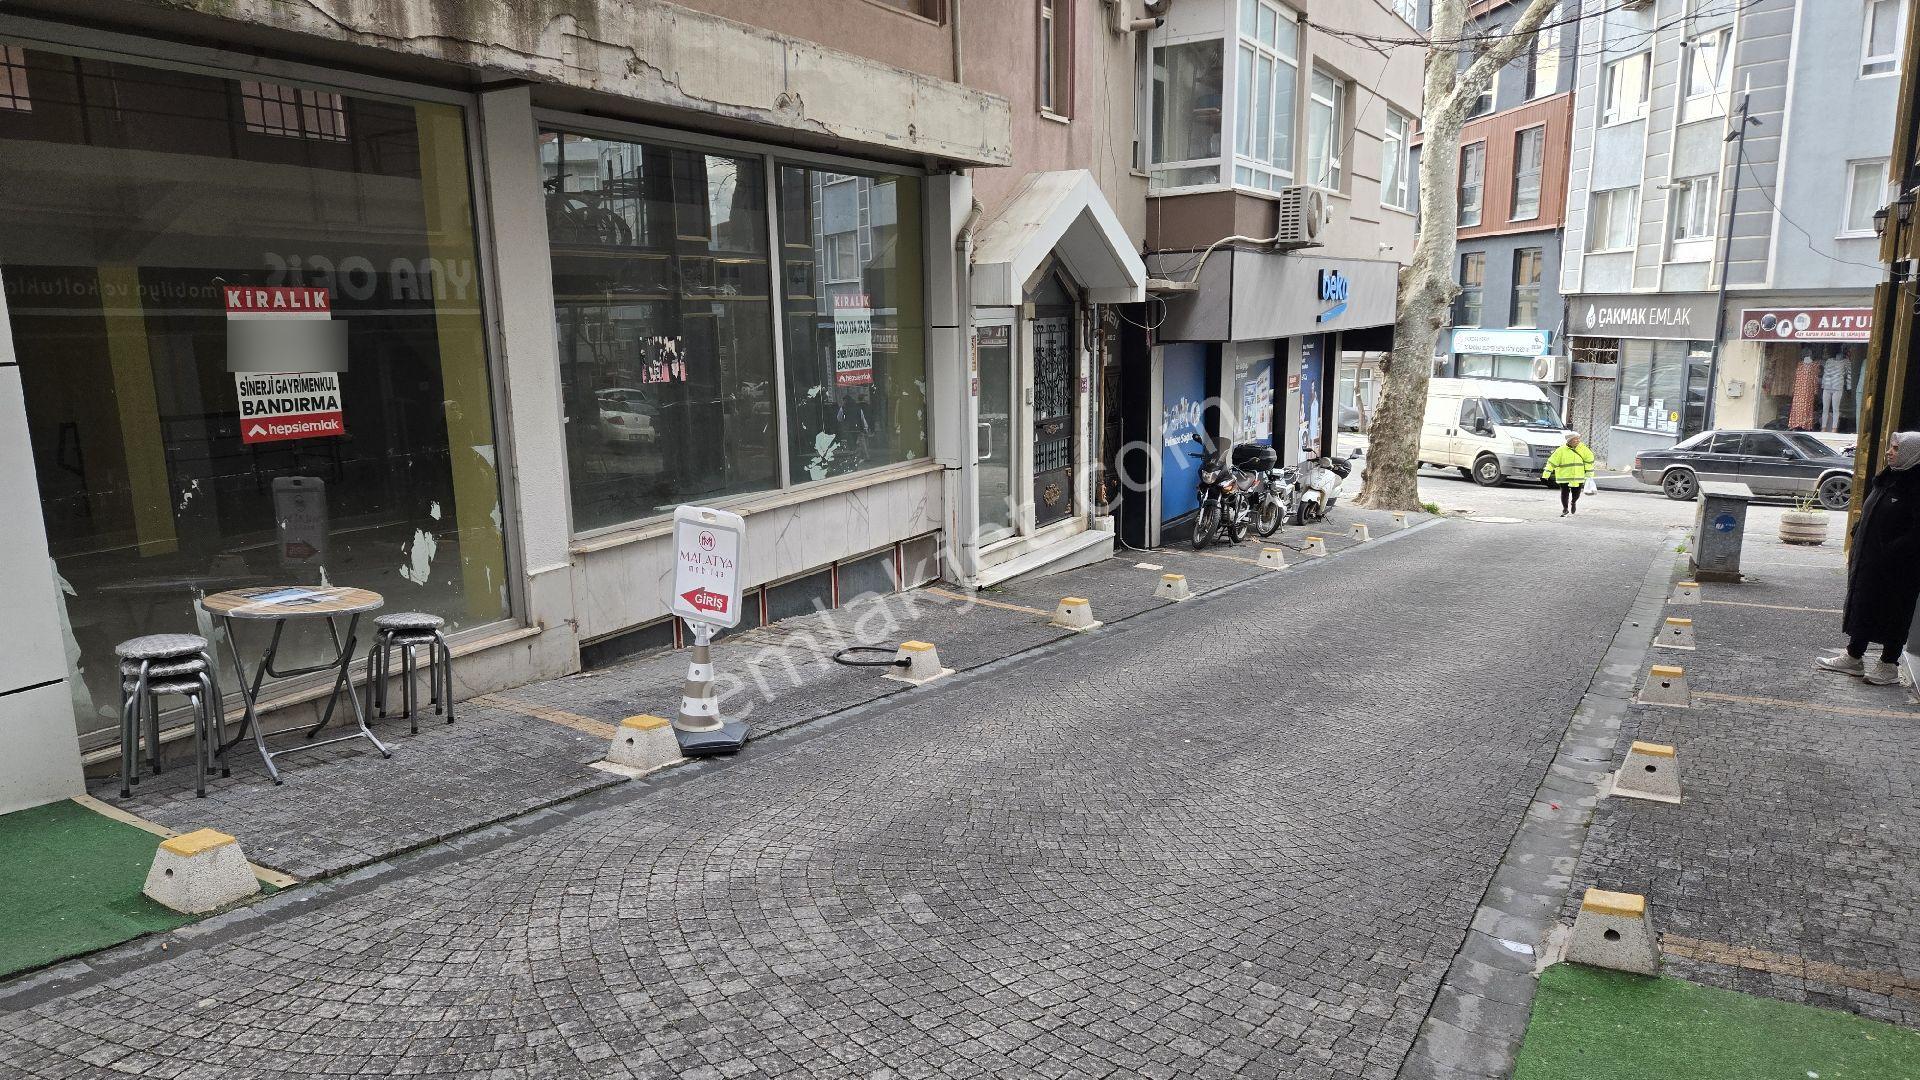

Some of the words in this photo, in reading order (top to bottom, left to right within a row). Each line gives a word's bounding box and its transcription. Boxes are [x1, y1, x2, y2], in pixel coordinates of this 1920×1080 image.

[1599, 307, 1647, 328] ÇAKMAK
[1649, 307, 1692, 325] EMLAK
[239, 375, 274, 397] SİNERJİ
[275, 373, 337, 395] GAYRİMENKUL
[241, 395, 339, 416] BANDIRMA
[268, 418, 339, 436] hepsiemlak
[680, 550, 733, 569] MALATYA
[694, 593, 723, 609] GİRİŞ
